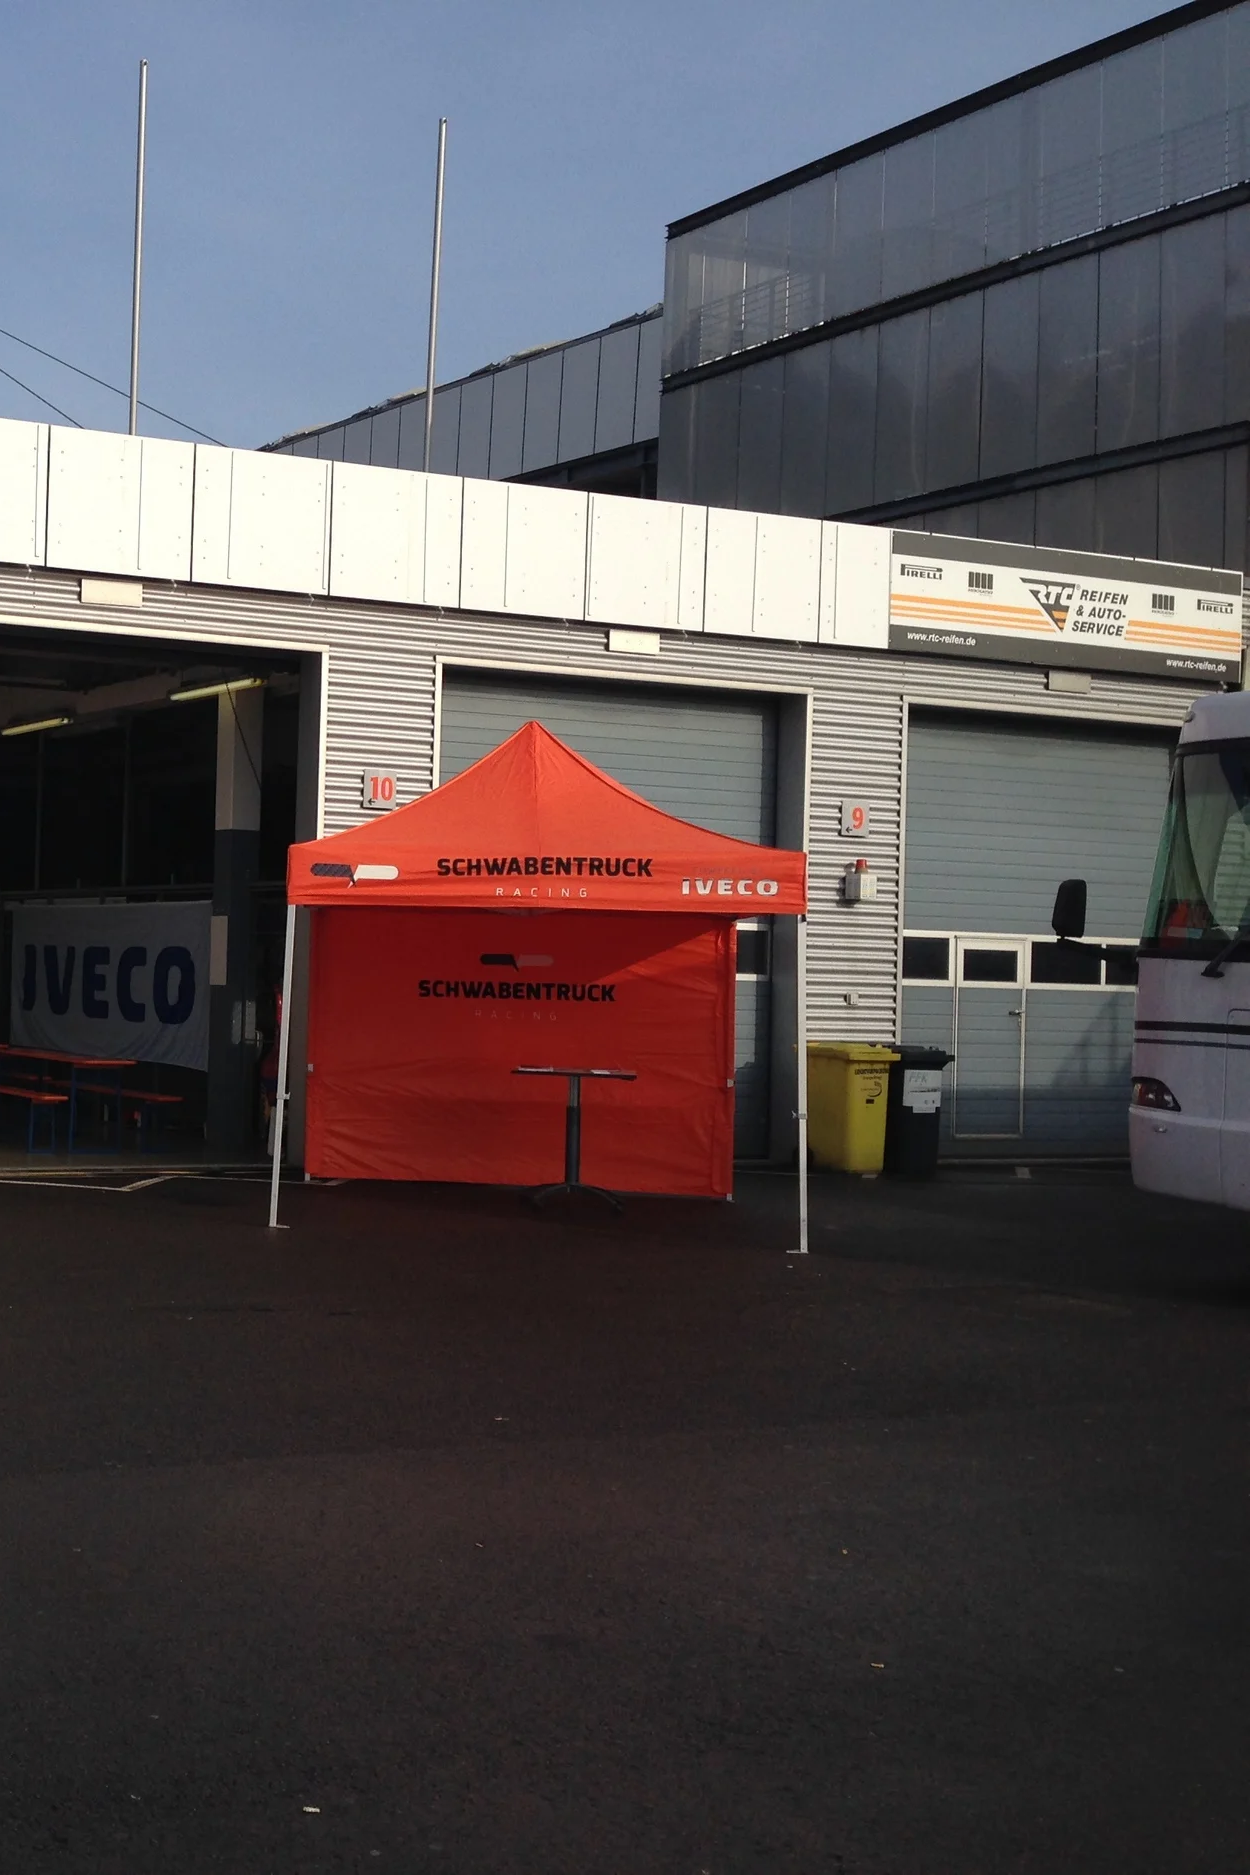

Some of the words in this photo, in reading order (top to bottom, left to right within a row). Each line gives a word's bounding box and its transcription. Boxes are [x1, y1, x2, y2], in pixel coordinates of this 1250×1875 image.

[900, 563, 943, 580] PIRELLI
[1023, 583, 1074, 606] RTC
[1080, 589, 1129, 605] REIFEN
[1076, 605, 1084, 616] &
[1088, 606, 1126, 620] AUTO-
[1197, 599, 1233, 614] PIRELLI
[1072, 621, 1124, 636] SERVICE
[907, 631, 976, 646] www.rtc-reifen.de
[1166, 659, 1227, 672] www.rtc-reifen.de
[370, 776, 393, 801] 10
[852, 807, 864, 829] 9
[437, 857, 653, 877] SCHWABENTRUCK
[496, 887, 588, 898] RACING
[682, 878, 779, 896] IVECO
[23, 944, 196, 1024] IVECO
[418, 980, 616, 1002] SCHWABENTRUCK
[474, 1010, 556, 1021] RACING
